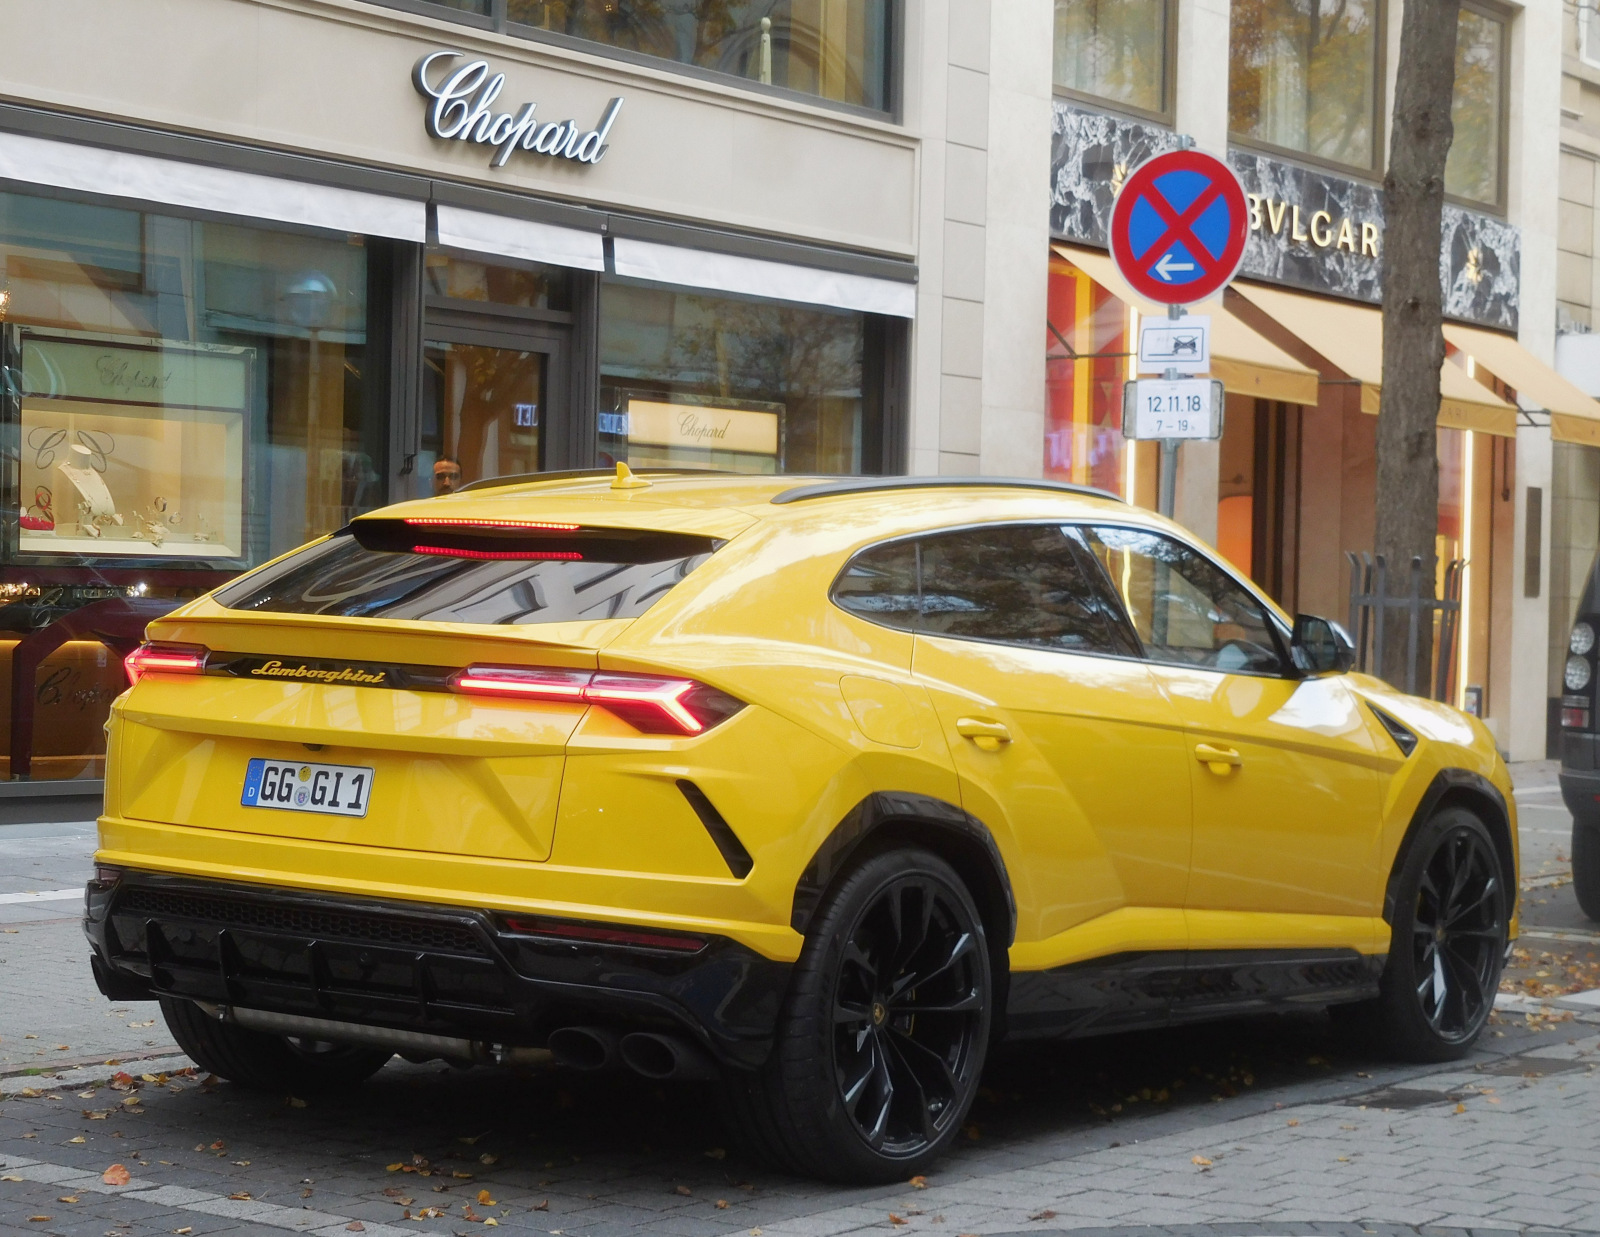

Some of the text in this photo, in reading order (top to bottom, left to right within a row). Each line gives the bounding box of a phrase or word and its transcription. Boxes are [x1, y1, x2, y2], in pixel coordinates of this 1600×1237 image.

[412, 51, 625, 167] Chopard
[1147, 395, 1202, 413] 12.11.18
[677, 411, 731, 442] Chopard
[1156, 420, 1163, 432] 7
[1178, 419, 1189, 431] 19
[251, 660, 386, 684] Lamborghini
[247, 786, 255, 798] D
[260, 766, 296, 803] GG
